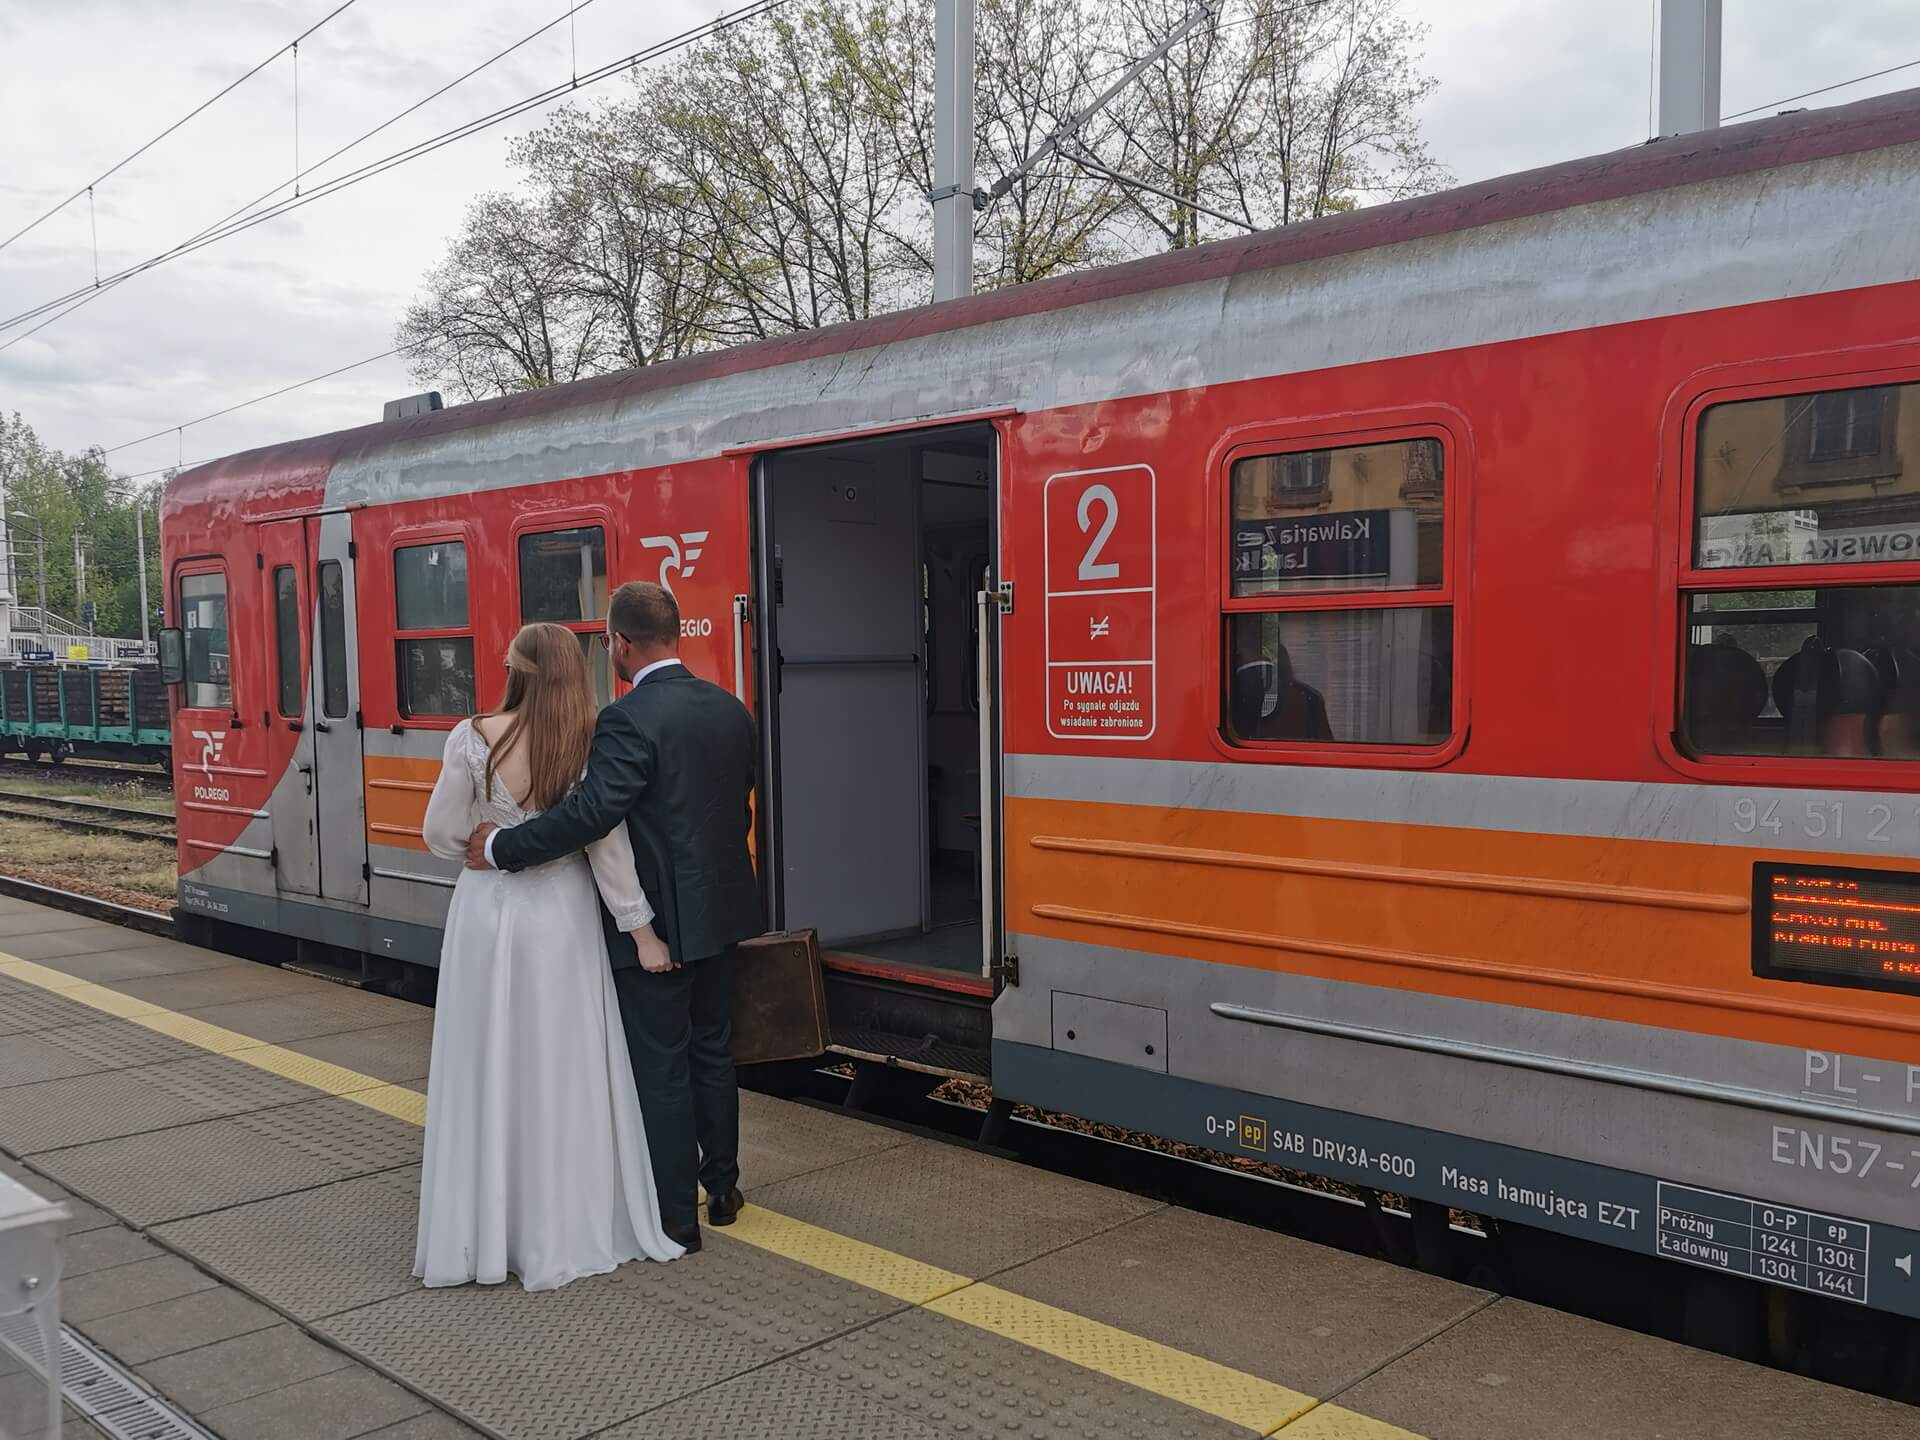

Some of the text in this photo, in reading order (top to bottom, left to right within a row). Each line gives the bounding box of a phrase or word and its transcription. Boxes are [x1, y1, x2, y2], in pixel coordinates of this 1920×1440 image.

[1077, 484, 1120, 581] 2
[680, 618, 712, 637] EGIO
[1067, 671, 1132, 695] UWAGA!
[1063, 699, 1140, 712] Po sygnale odjazdu
[1060, 716, 1143, 728] wsiadanie zabronione
[194, 786, 230, 801] POLREGIO
[1733, 798, 1783, 835] 94
[1804, 800, 1844, 839] 51
[1867, 804, 1893, 842] 2
[1244, 1125, 1262, 1145] ep
[1272, 1130, 1305, 1154] SAB
[1313, 1138, 1416, 1179] DRV3A-600
[1441, 1166, 1489, 1196] Masa
[1498, 1178, 1588, 1220] hamująca
[1598, 1201, 1640, 1231] EZT
[1661, 1209, 1857, 1271] Próżny 124t 130t
[1828, 1225, 1847, 1244] ep
[1660, 1233, 1854, 1295] Ładowny 130t 144t
